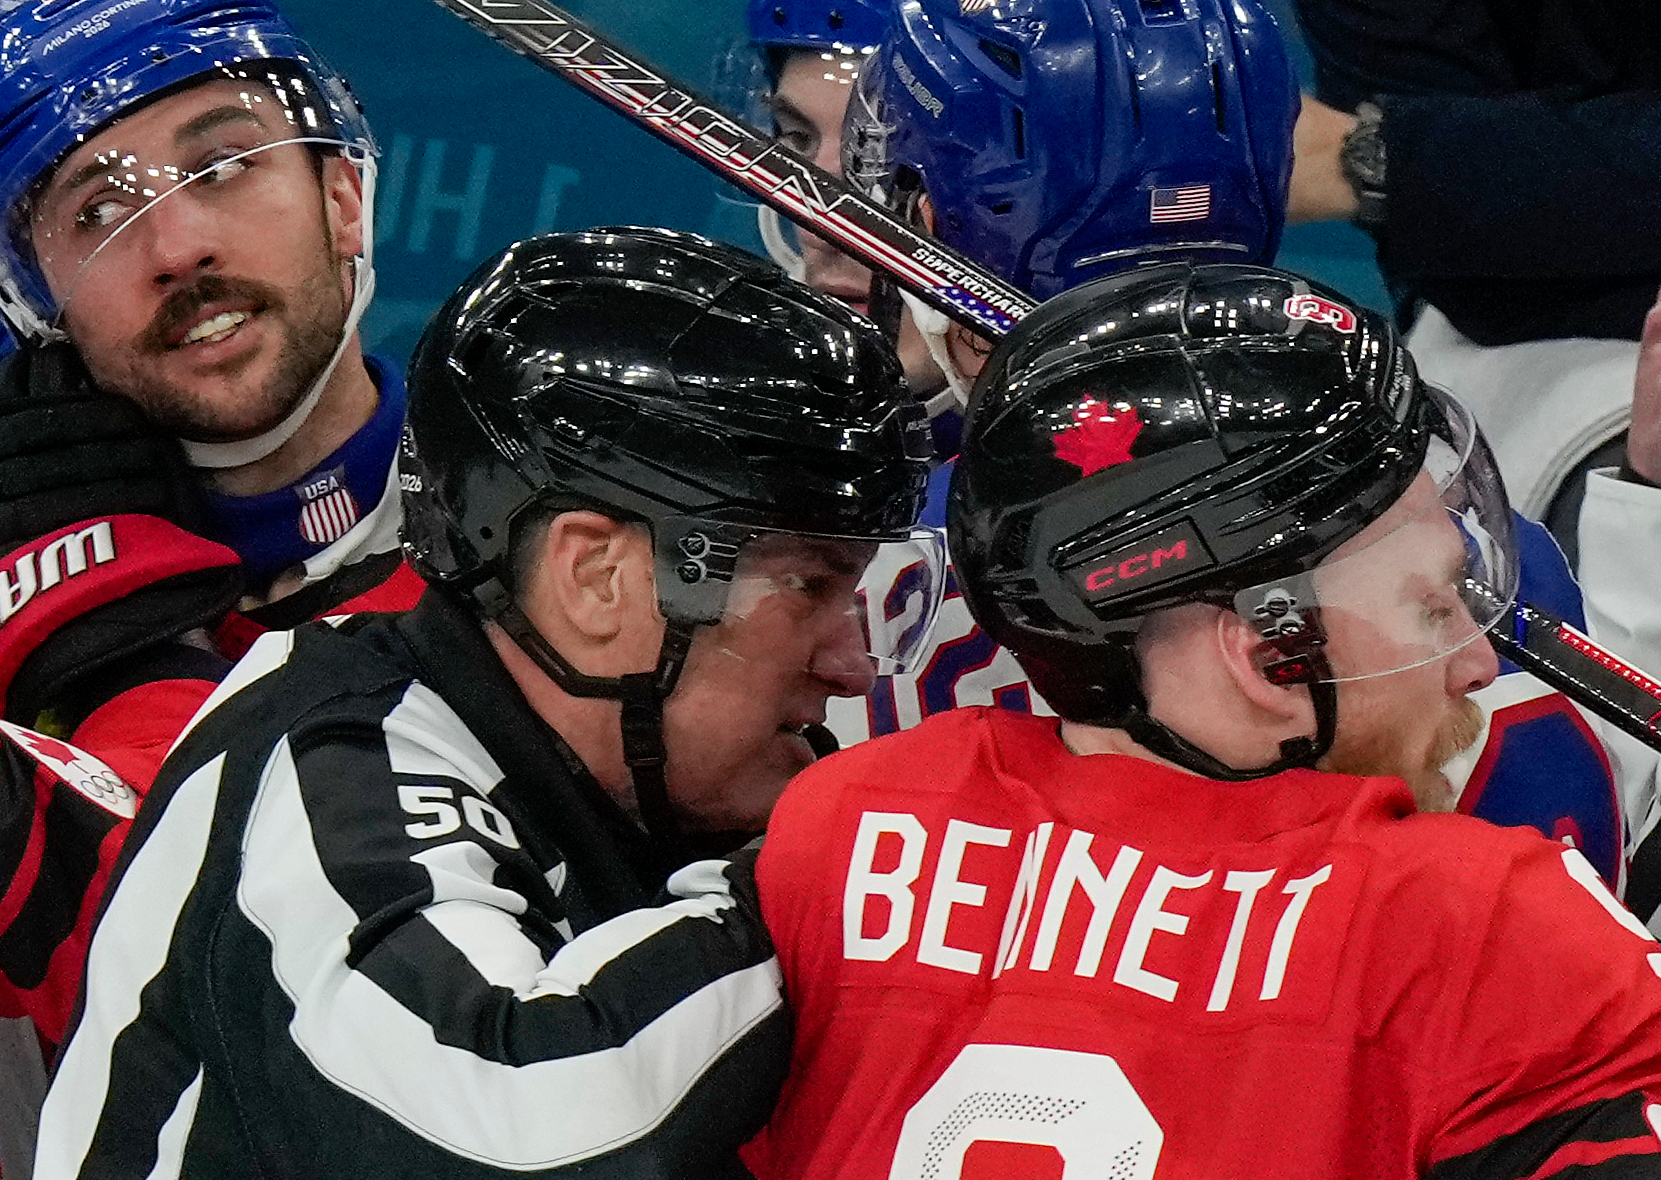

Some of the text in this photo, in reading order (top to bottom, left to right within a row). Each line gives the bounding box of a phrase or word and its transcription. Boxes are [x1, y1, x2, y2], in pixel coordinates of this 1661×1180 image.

[43, 0, 147, 56] MILANO CORTIN
[305, 475, 340, 500] USA
[400, 473, 423, 493] 026
[1085, 539, 1190, 592] CCM
[400, 786, 521, 850] 50
[843, 811, 1333, 1013] BENNETT
